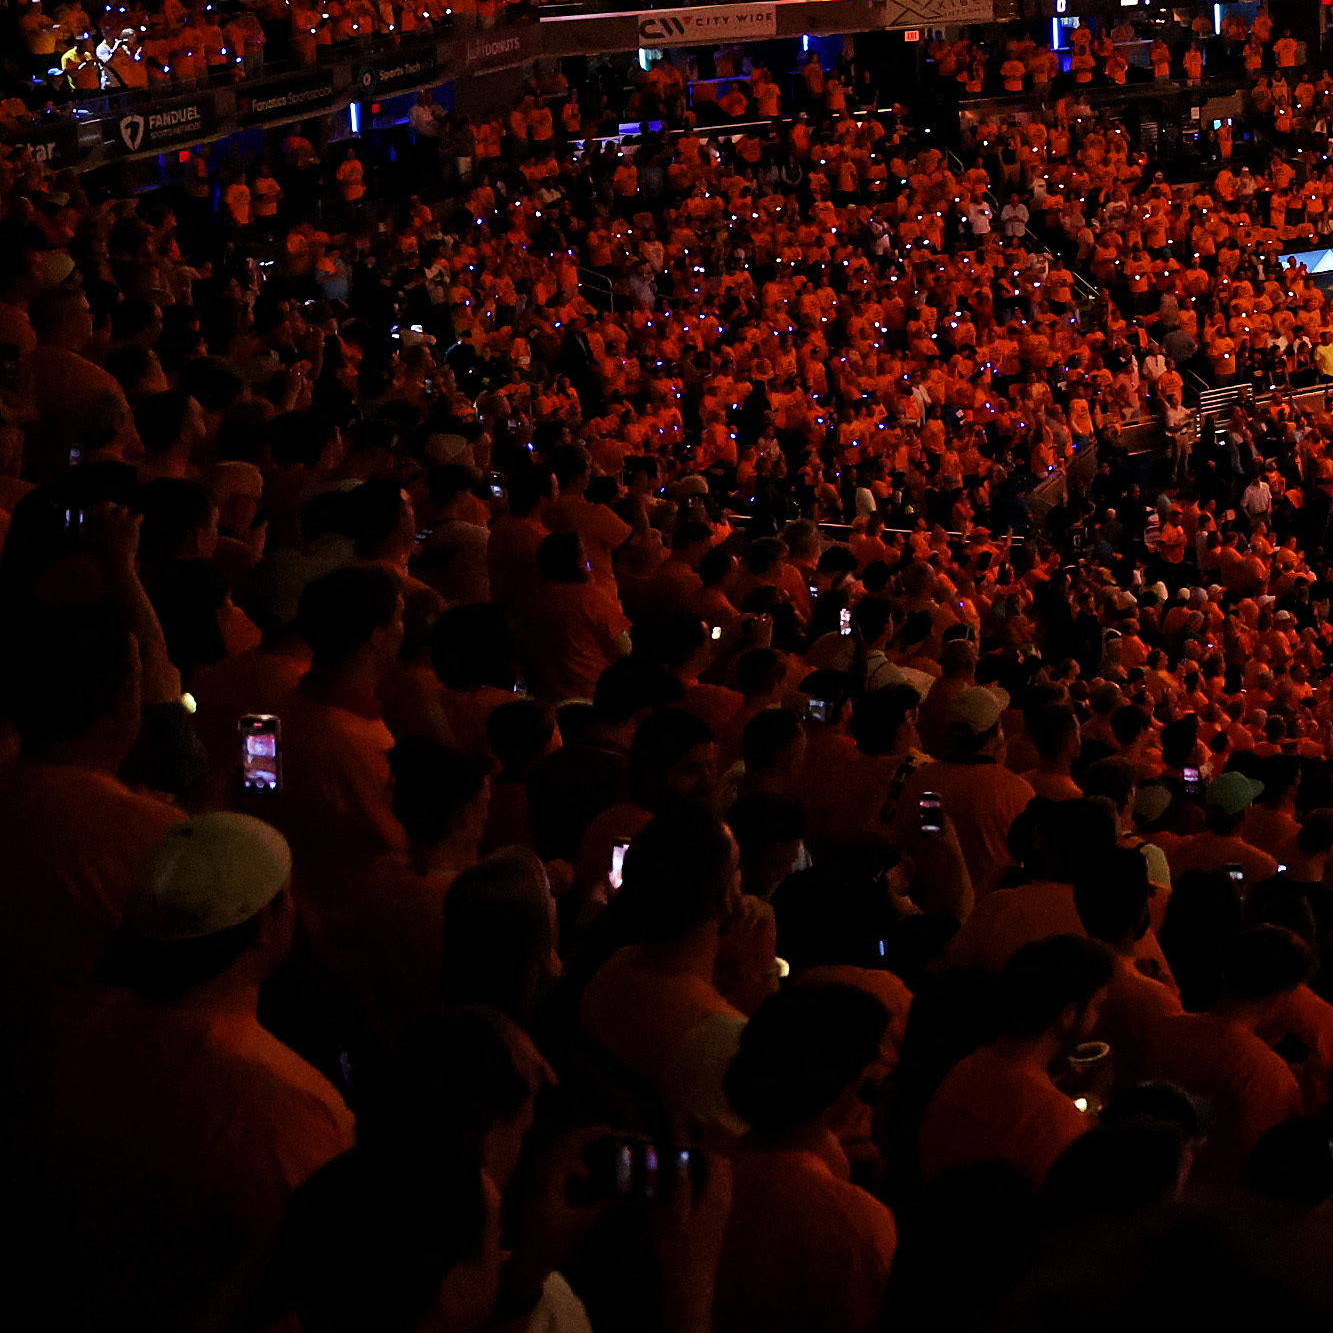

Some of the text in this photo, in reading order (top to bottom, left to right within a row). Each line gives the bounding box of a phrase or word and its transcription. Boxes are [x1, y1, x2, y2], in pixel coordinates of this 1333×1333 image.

[695, 16, 729, 27] CITY
[736, 12, 773, 23] WIDE
[149, 105, 201, 130] FANDUEL
